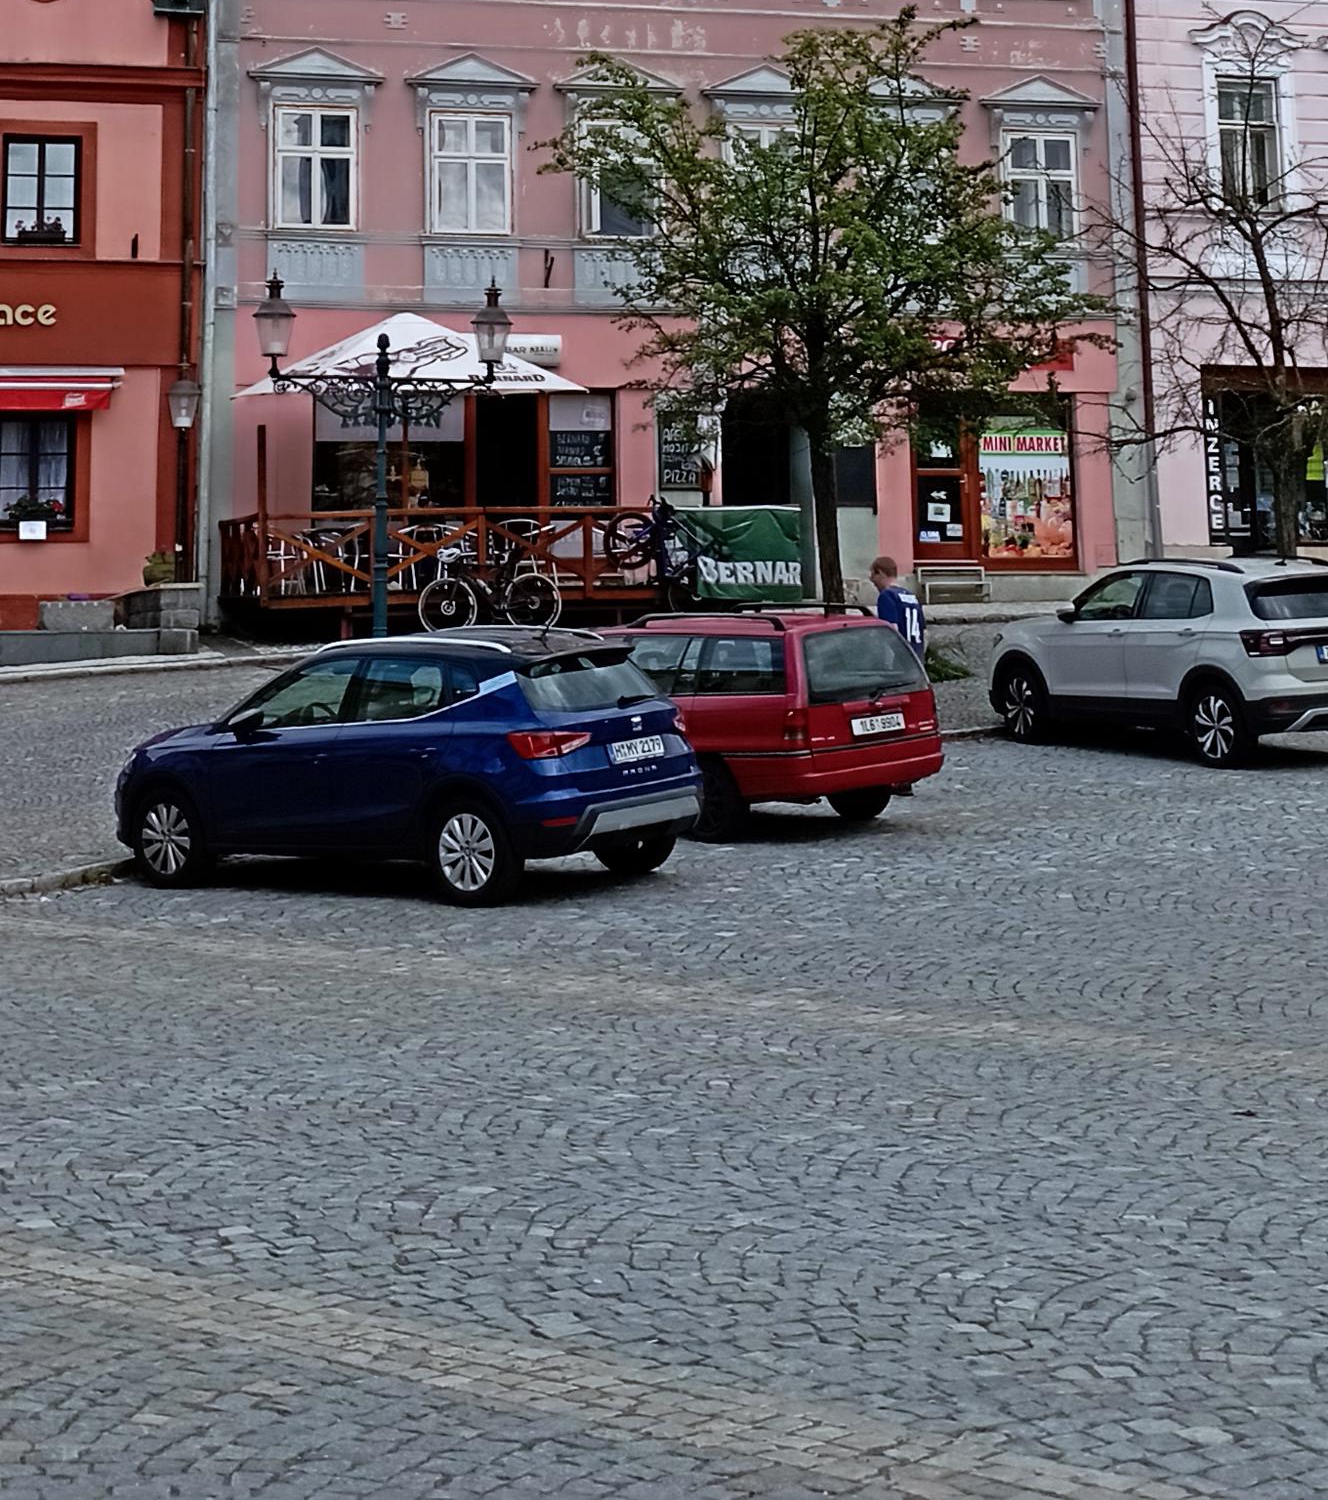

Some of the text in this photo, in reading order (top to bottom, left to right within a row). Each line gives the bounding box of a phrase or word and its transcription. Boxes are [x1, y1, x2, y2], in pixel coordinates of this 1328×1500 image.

[983, 436, 1066, 453] MINI MARKET
[663, 469, 697, 485] PIZZA
[1205, 399, 1225, 530] INZERCE
[905, 607, 922, 643] 14
